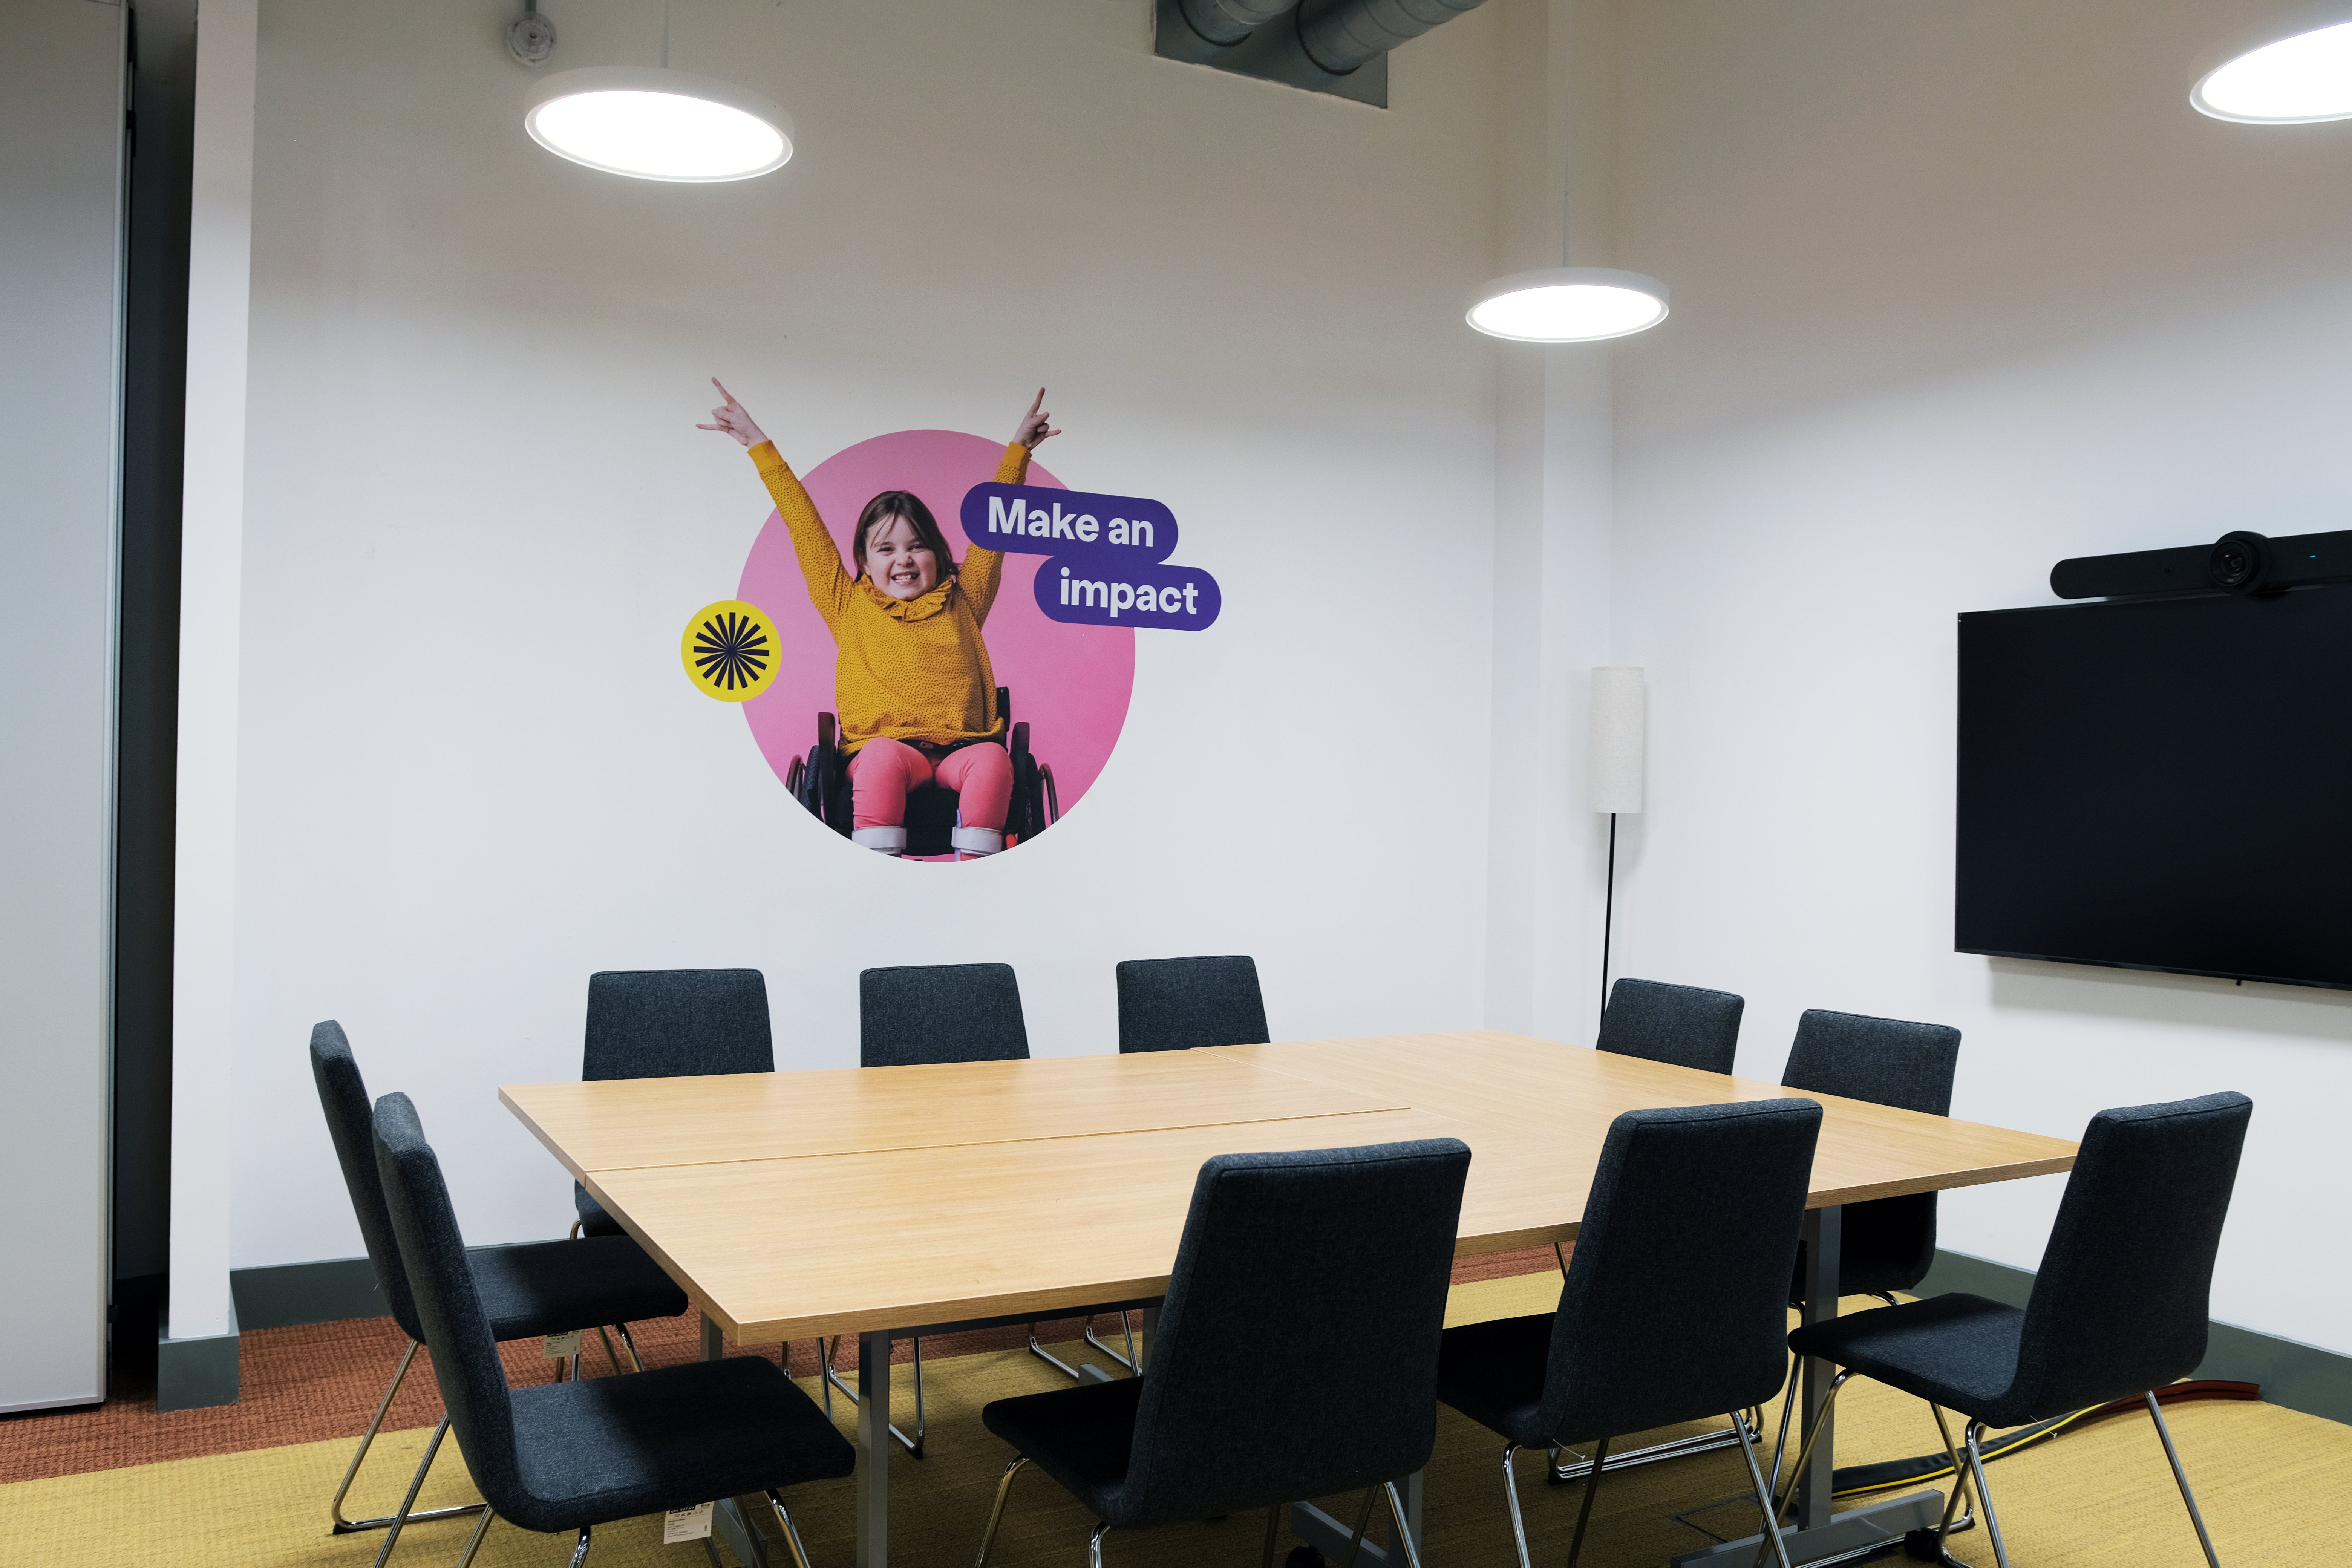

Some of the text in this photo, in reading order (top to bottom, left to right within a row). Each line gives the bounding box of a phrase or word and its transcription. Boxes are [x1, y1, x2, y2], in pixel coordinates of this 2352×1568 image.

[988, 496, 1153, 547] Make an
[1060, 567, 1198, 618] impact
